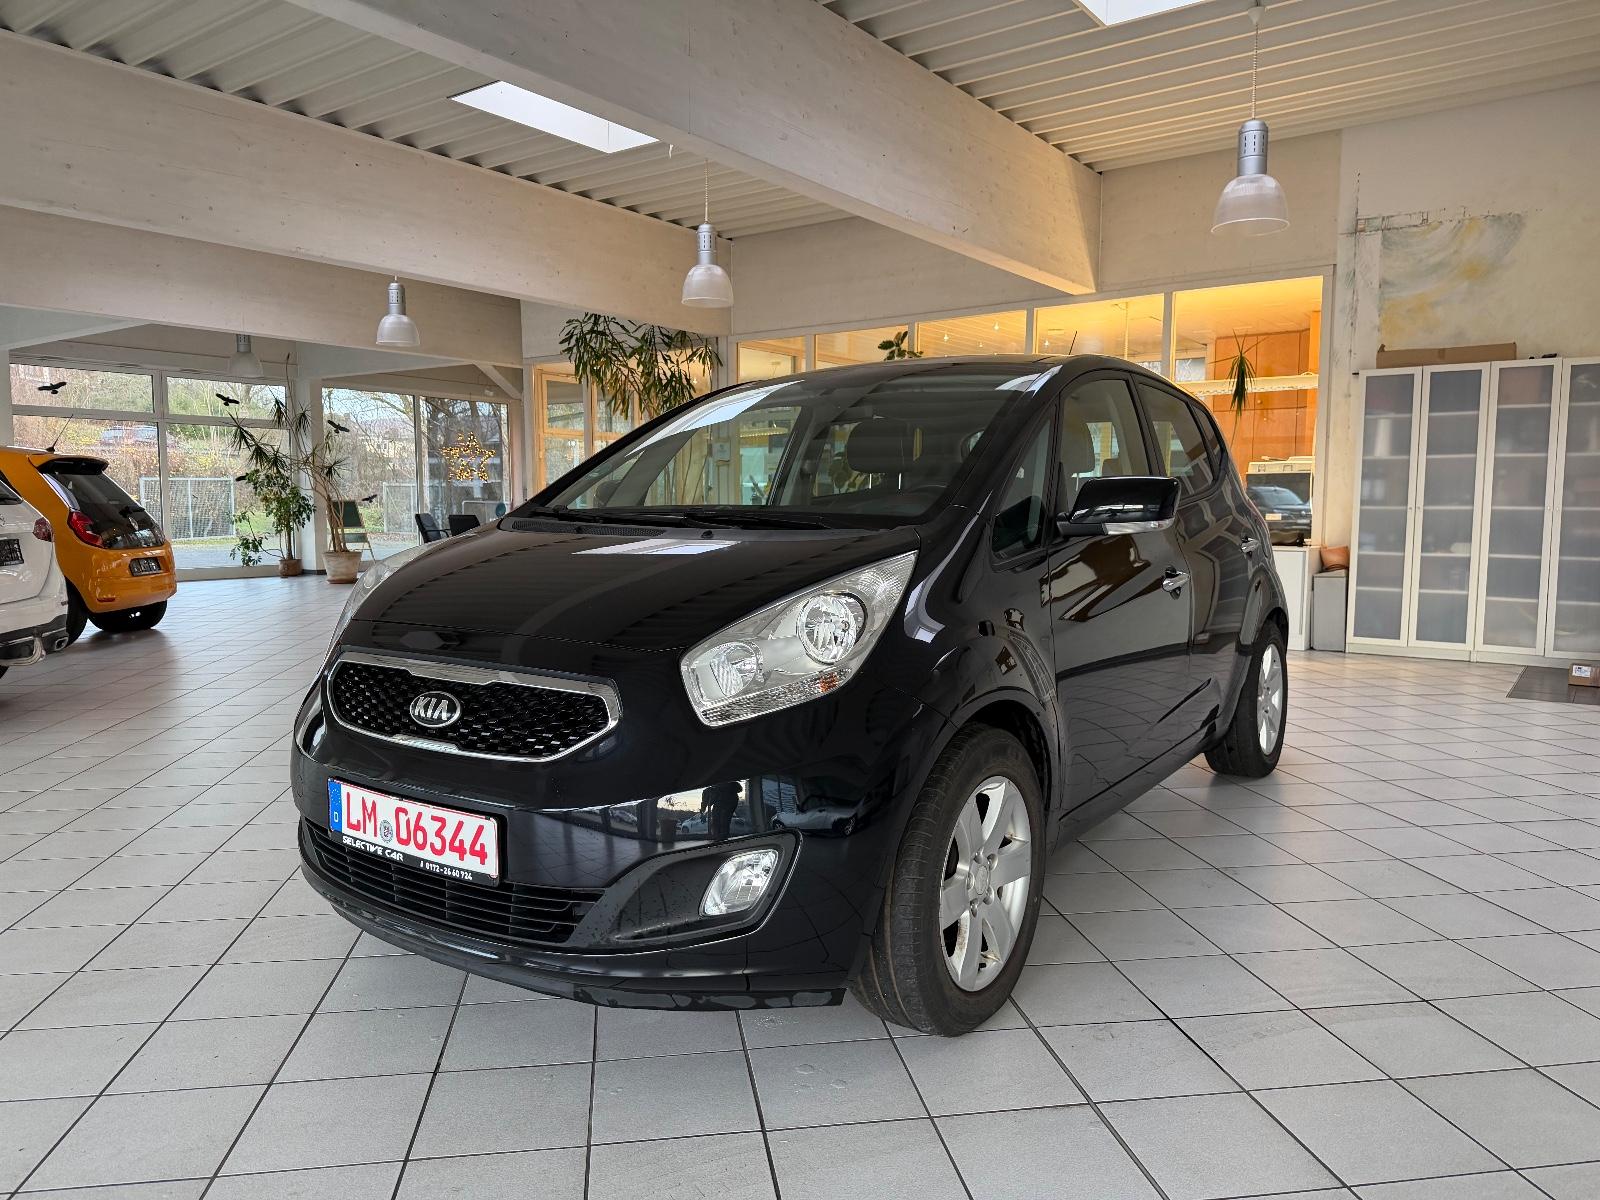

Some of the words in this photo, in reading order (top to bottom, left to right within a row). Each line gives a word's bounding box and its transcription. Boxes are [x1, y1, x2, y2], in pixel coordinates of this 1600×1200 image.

[414, 696, 448, 720] KIA
[333, 811, 339, 823] D
[346, 791, 378, 838] LM
[394, 806, 488, 866] 06344
[342, 835, 384, 855] SELECTIVE
